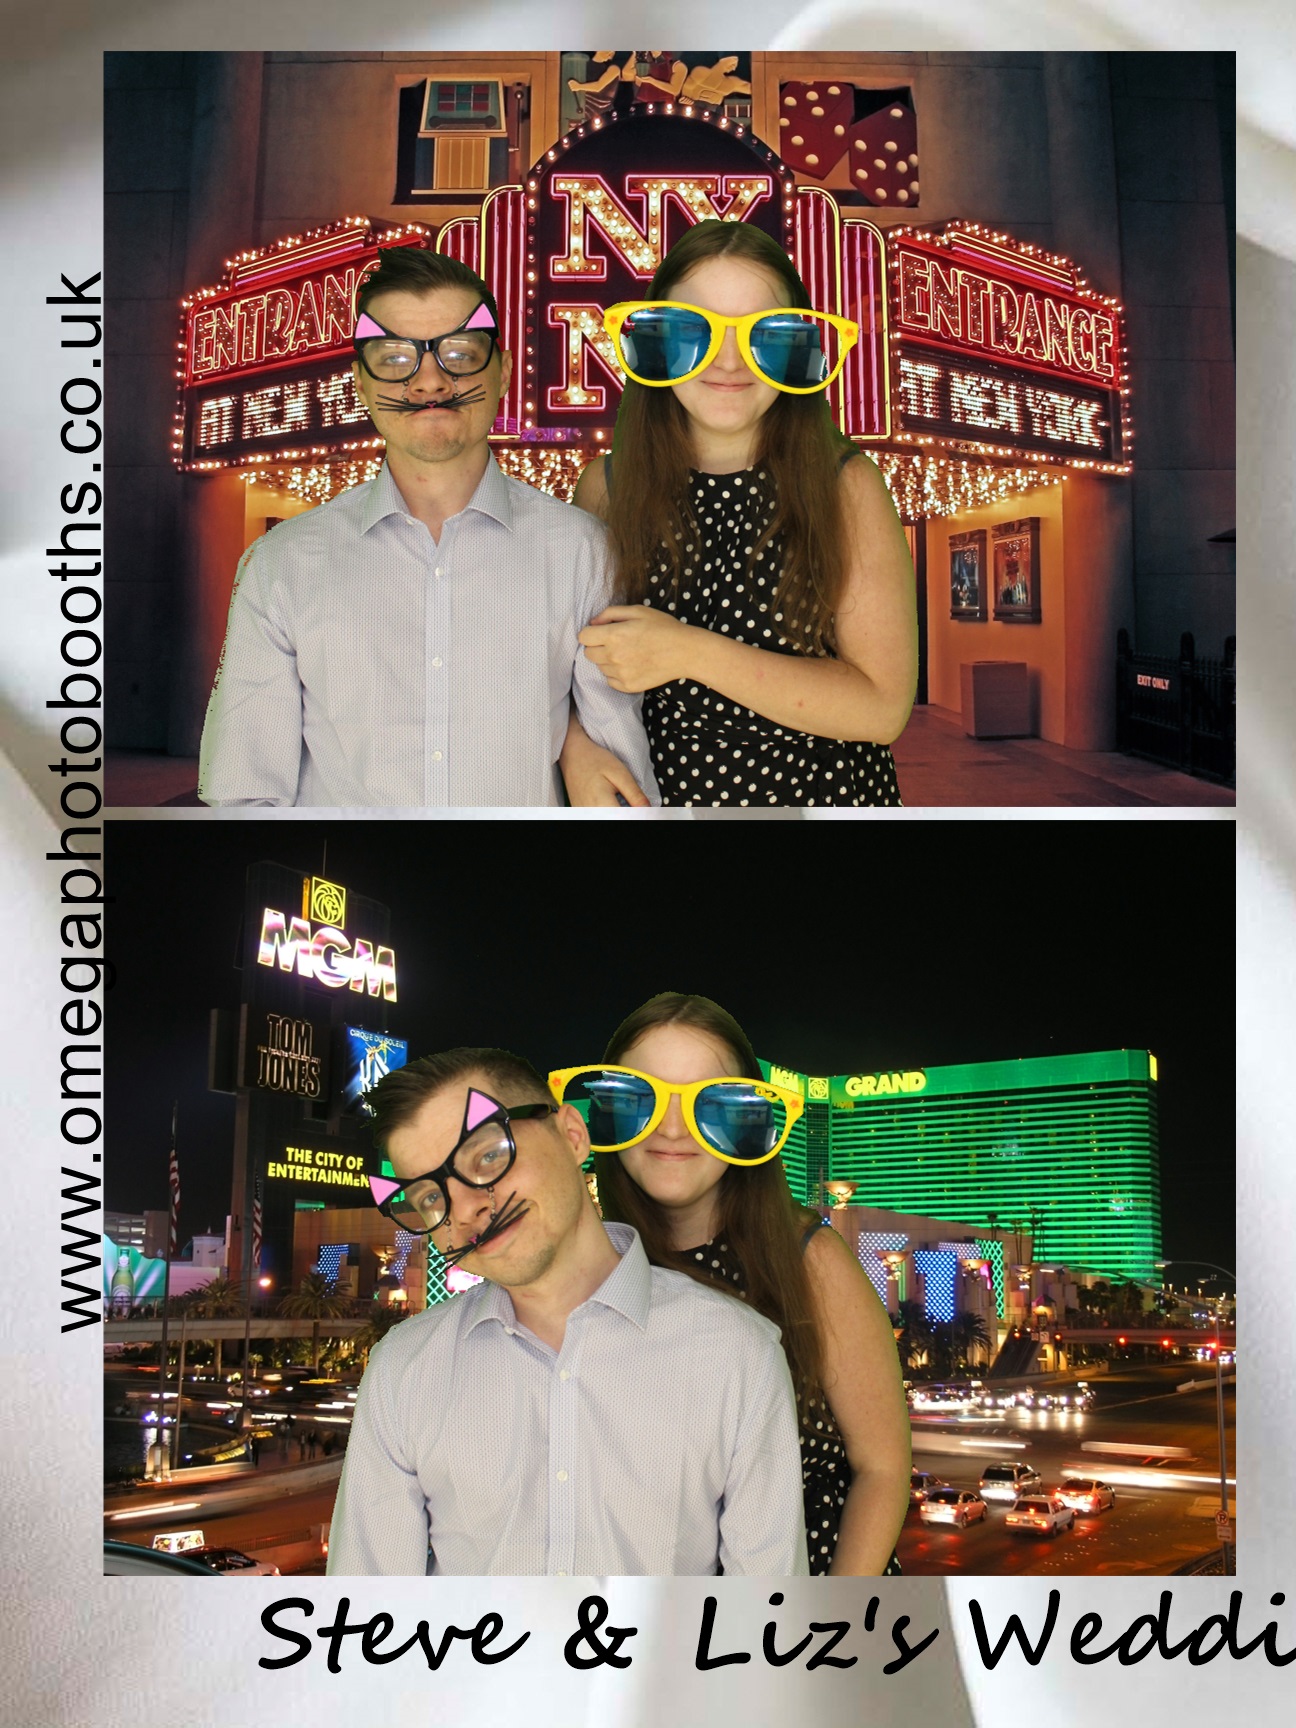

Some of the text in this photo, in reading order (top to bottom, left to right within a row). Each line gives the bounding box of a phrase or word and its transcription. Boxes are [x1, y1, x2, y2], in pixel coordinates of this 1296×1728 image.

[551, 174, 773, 280] NY
[192, 260, 379, 374] ENTRAN
[899, 250, 1115, 378] ENTRANCE
[257, 907, 398, 1003] MGM
[266, 1012, 313, 1056] TOM
[349, 1028, 373, 1041] CIRQUE
[257, 1051, 321, 1098] JONES
[845, 1071, 927, 1097] GRAND
[267, 1162, 370, 1188] ENTERTAINMEN
[286, 1146, 364, 1171] THE CITY OF
